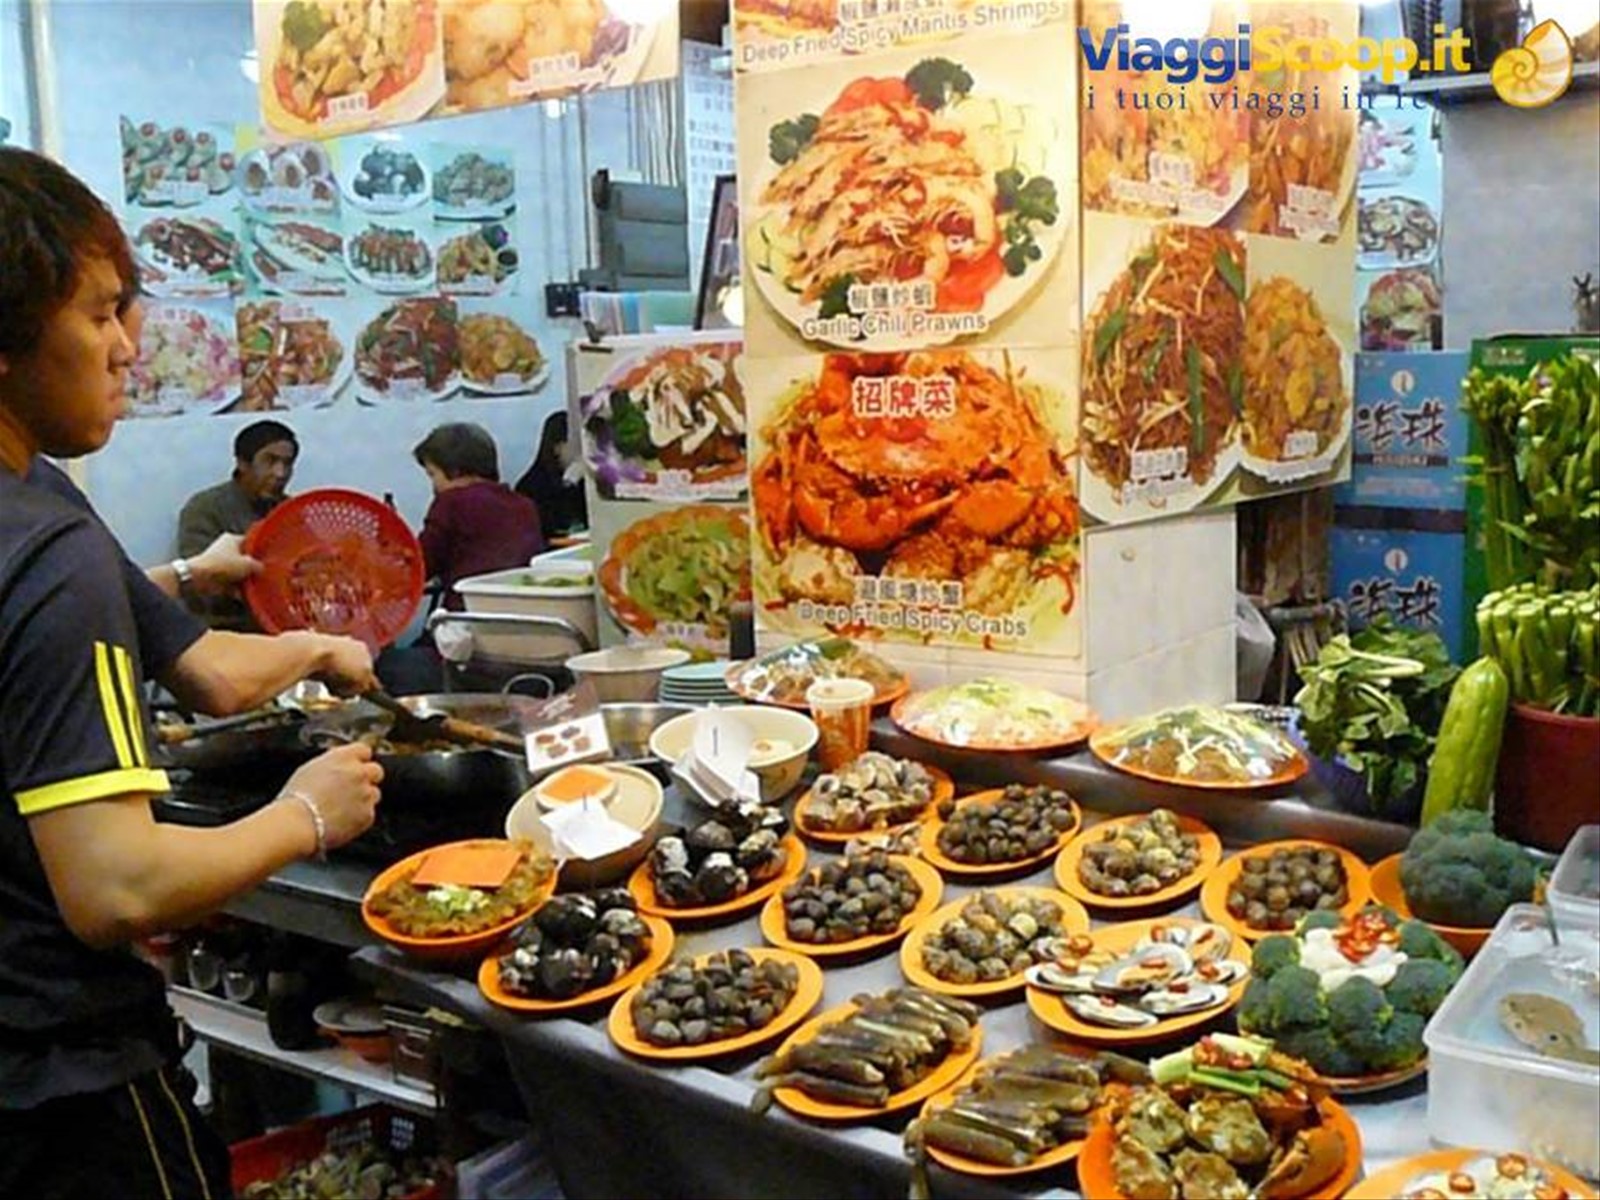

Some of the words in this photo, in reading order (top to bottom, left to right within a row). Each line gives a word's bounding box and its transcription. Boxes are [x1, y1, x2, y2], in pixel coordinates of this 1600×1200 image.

[743, 43, 789, 63] Deep
[794, 33, 841, 54] Fried
[847, 27, 899, 47] Spicy
[903, 13, 968, 36] Mantis
[975, 1, 1060, 26] Shrimps
[802, 316, 859, 337] Garlic
[863, 313, 907, 334] Chili
[911, 314, 986, 333] Prawns
[855, 379, 953, 415] 招牌菜
[800, 602, 847, 623] Deep
[853, 606, 904, 627] Fried
[907, 609, 961, 632] Spicy
[966, 614, 1028, 637] Crabs
